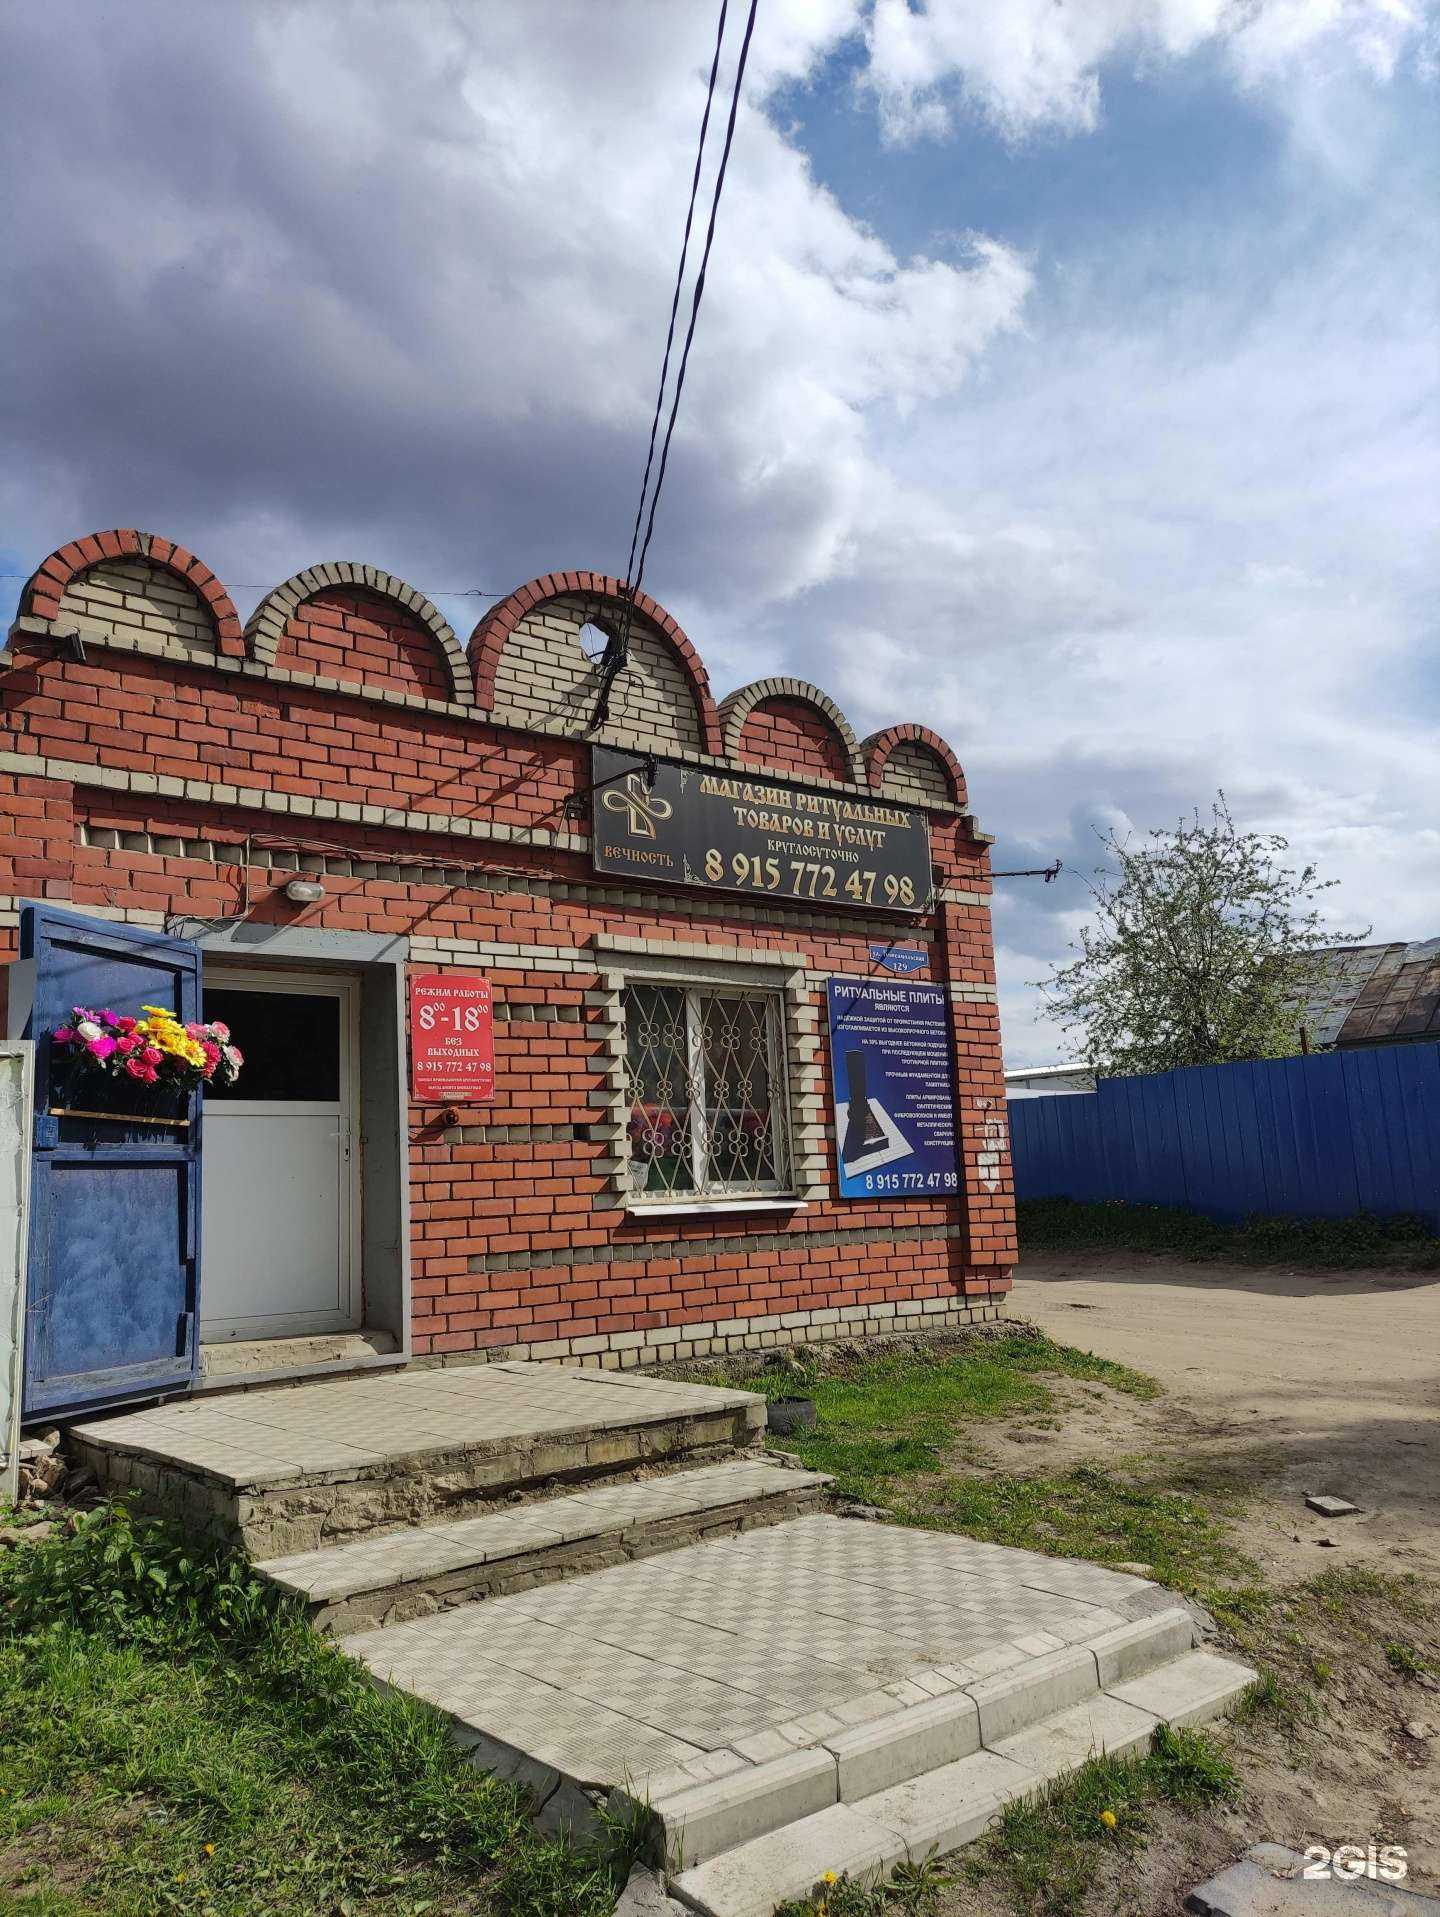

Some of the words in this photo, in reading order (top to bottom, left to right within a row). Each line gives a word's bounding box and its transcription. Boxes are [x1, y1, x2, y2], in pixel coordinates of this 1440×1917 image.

[700, 774, 793, 809] МАГАЗИН
[796, 792, 911, 829] РИТУАЛЬНЫХ
[733, 806, 814, 836] ТОВАРОВ
[817, 821, 831, 840] И
[833, 823, 886, 852] УСЛУГ
[604, 845, 674, 867] ВЕЧНОСТЬ
[767, 839, 859, 863] КРУГЛОСУТОЧНО
[704, 848, 724, 882] 8
[732, 852, 781, 890] 915
[790, 861, 837, 898] 772
[844, 869, 877, 904] 47
[883, 874, 915, 906] 98
[893, 962, 908, 971] 129
[415, 987, 452, 997] РЕЖИМ
[453, 989, 489, 999] РАБОТЫ
[834, 986, 907, 1003] РИТУАЛЬНЫЕ
[909, 991, 945, 1005] ПЛИТЫ
[874, 1003, 910, 1013] ЯВЛЯЮТСЯ
[445, 1037, 462, 1046] БЕЗ
[427, 1047, 480, 1058] ВЫХОДНЫХ
[417, 1061, 424, 1071] 8
[425, 1061, 443, 1072] 915
[445, 1061, 463, 1072] 772
[465, 1062, 478, 1073] 47
[479, 1062, 492, 1072] 98
[865, 1174, 874, 1190] 8
[876, 1174, 900, 1189] 915
[902, 1173, 924, 1189] 772
[927, 1172, 941, 1188] 47
[944, 1172, 958, 1187] 98
